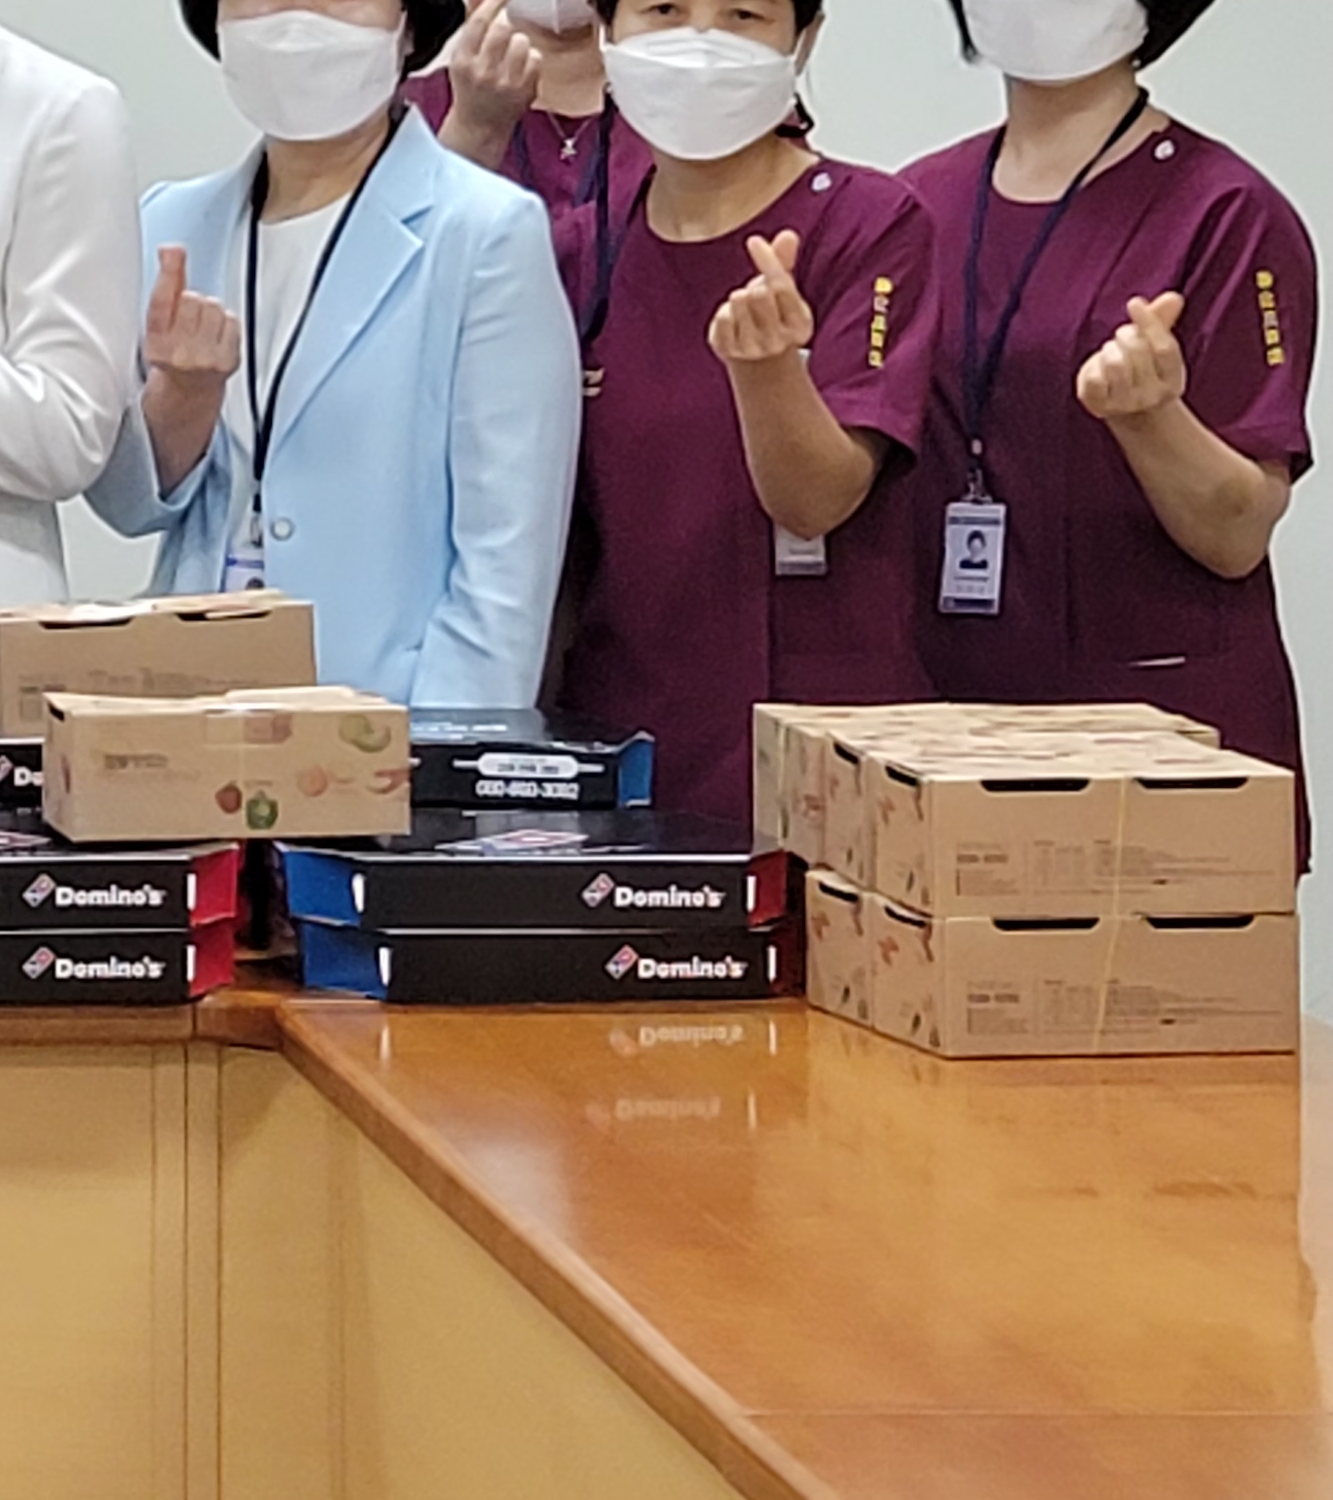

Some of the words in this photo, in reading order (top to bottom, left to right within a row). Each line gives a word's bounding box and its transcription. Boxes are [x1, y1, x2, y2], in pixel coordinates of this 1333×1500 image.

[54, 883, 166, 907] Domino's
[613, 883, 726, 908] Domino's
[54, 956, 166, 979] Domino's
[636, 955, 747, 980] Domino's
